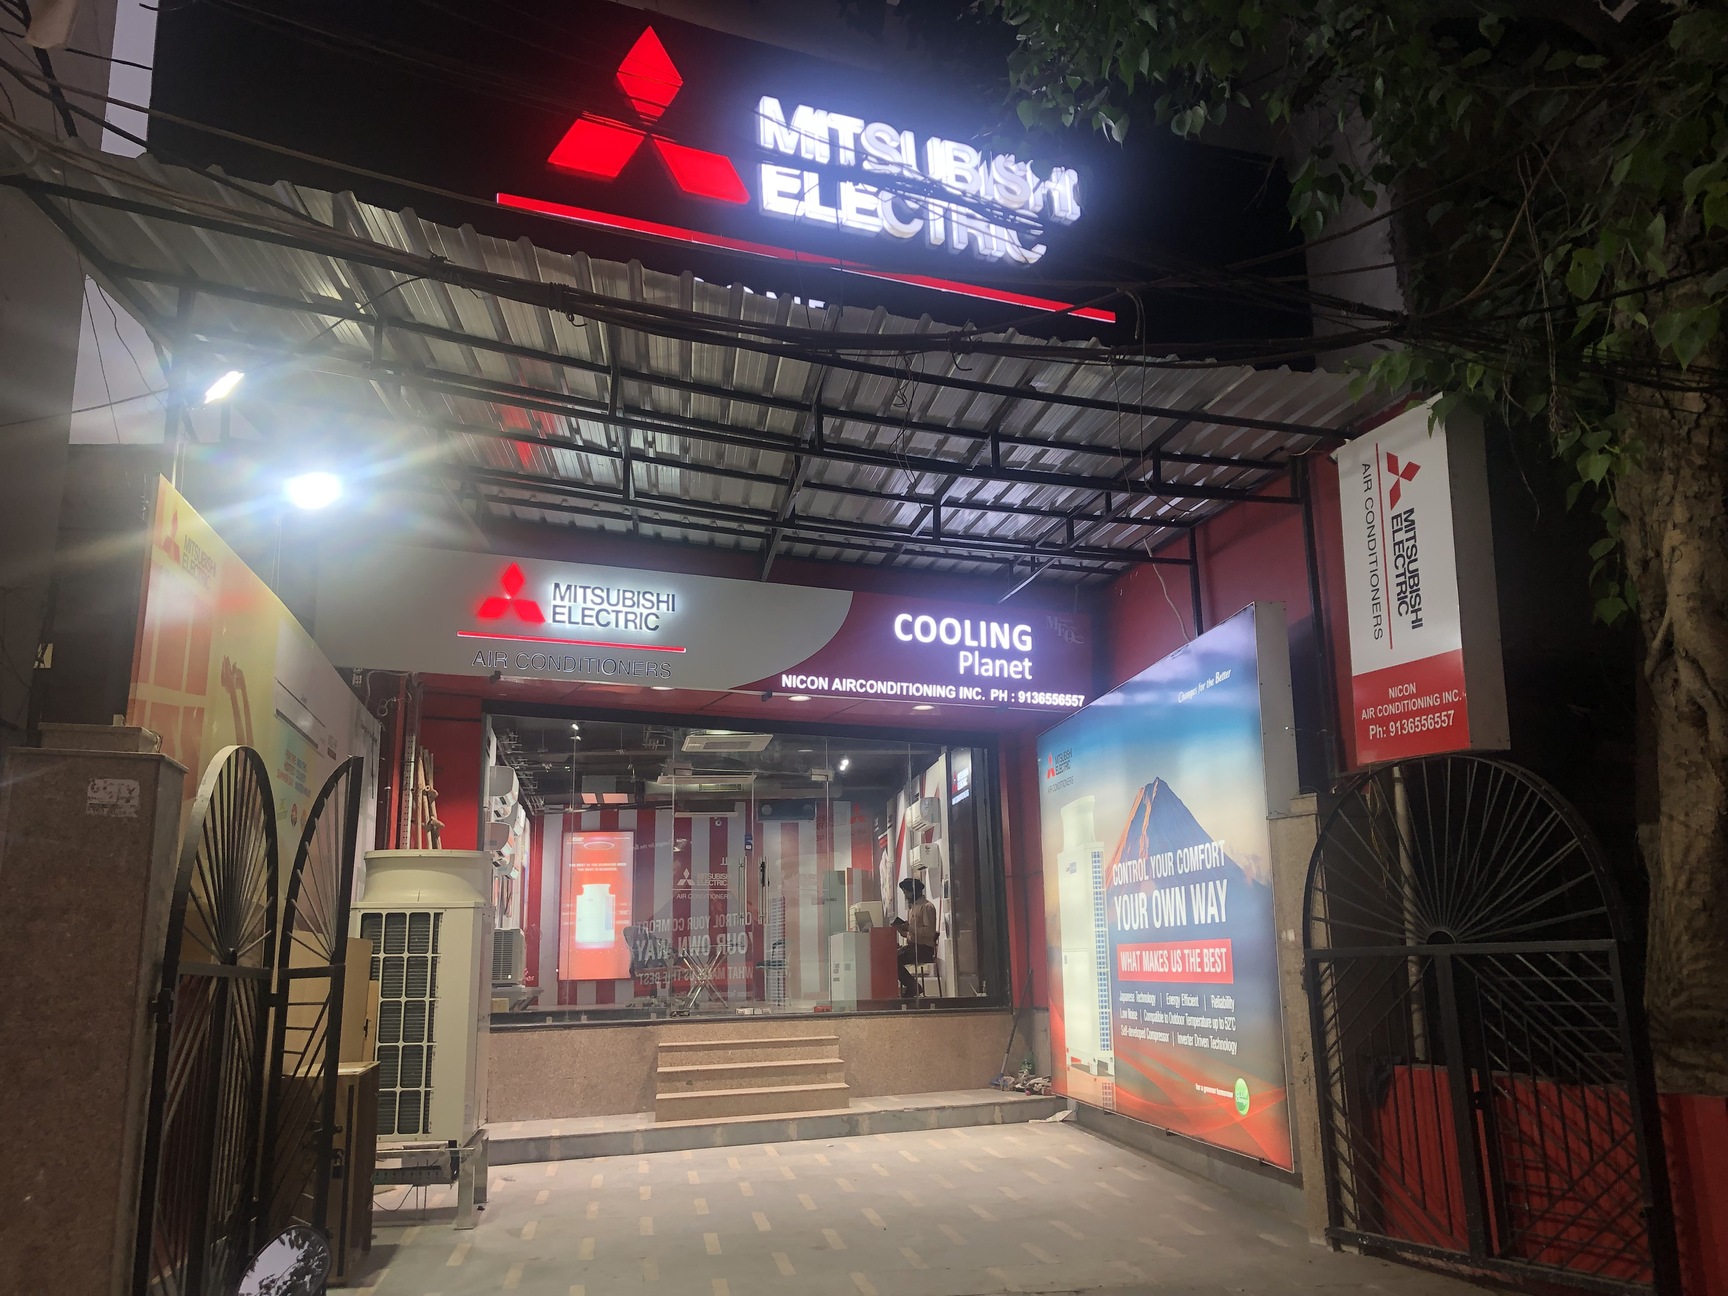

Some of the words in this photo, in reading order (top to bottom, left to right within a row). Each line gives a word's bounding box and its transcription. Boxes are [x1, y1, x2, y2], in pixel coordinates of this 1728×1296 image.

[756, 95, 1082, 226] MITSUBISHI
[757, 161, 1048, 264] ELECTRIC
[1361, 462, 1373, 493] AIR
[1363, 497, 1384, 641] CONDITIONERS
[1391, 512, 1410, 617] ELECTRIC
[1403, 507, 1424, 630] MITSUBISHI
[552, 582, 677, 613] MITSUBISHI
[552, 604, 660, 632] ELECTRIC
[893, 613, 1033, 652] COOLING
[471, 649, 508, 669] AIR
[514, 652, 673, 680] CONDITIONERS
[958, 650, 1033, 681] Planet
[781, 673, 829, 691] NICON
[831, 677, 957, 699] AIRCONDITIONING
[958, 687, 986, 701] INC.
[990, 688, 1008, 702] PH
[1017, 690, 1086, 708] 9136556557
[1206, 677, 1215, 689] the
[1388, 682, 1417, 699] NICON
[1361, 708, 1376, 720] AIR
[1376, 695, 1441, 717] CONDITIONING
[1442, 690, 1463, 706] INC.
[1368, 723, 1388, 740] Ph:
[1389, 709, 1456, 738] 9136556557
[1112, 857, 1149, 887] CONTROL
[1150, 851, 1175, 879] YOUR
[1176, 839, 1226, 875] COMFORT
[1114, 891, 1149, 931] YOUR
[1151, 886, 1188, 929] OWN
[1190, 878, 1228, 925] WAY
[1120, 950, 1142, 972] WHAT
[1142, 949, 1170, 973] MAKES
[1170, 948, 1183, 973] US
[1184, 948, 1202, 973] THE
[1203, 947, 1227, 973] BEST
[1166, 992, 1181, 1009] Energy
[1181, 993, 1199, 1008] Efficient
[1211, 994, 1235, 1013] Reliability
[1119, 1007, 1128, 1019] Low
[1185, 1012, 1212, 1030] Temperature
[1212, 1018, 1219, 1032] up
[1219, 1016, 1225, 1030] to
[1209, 1035, 1238, 1056] Technology
